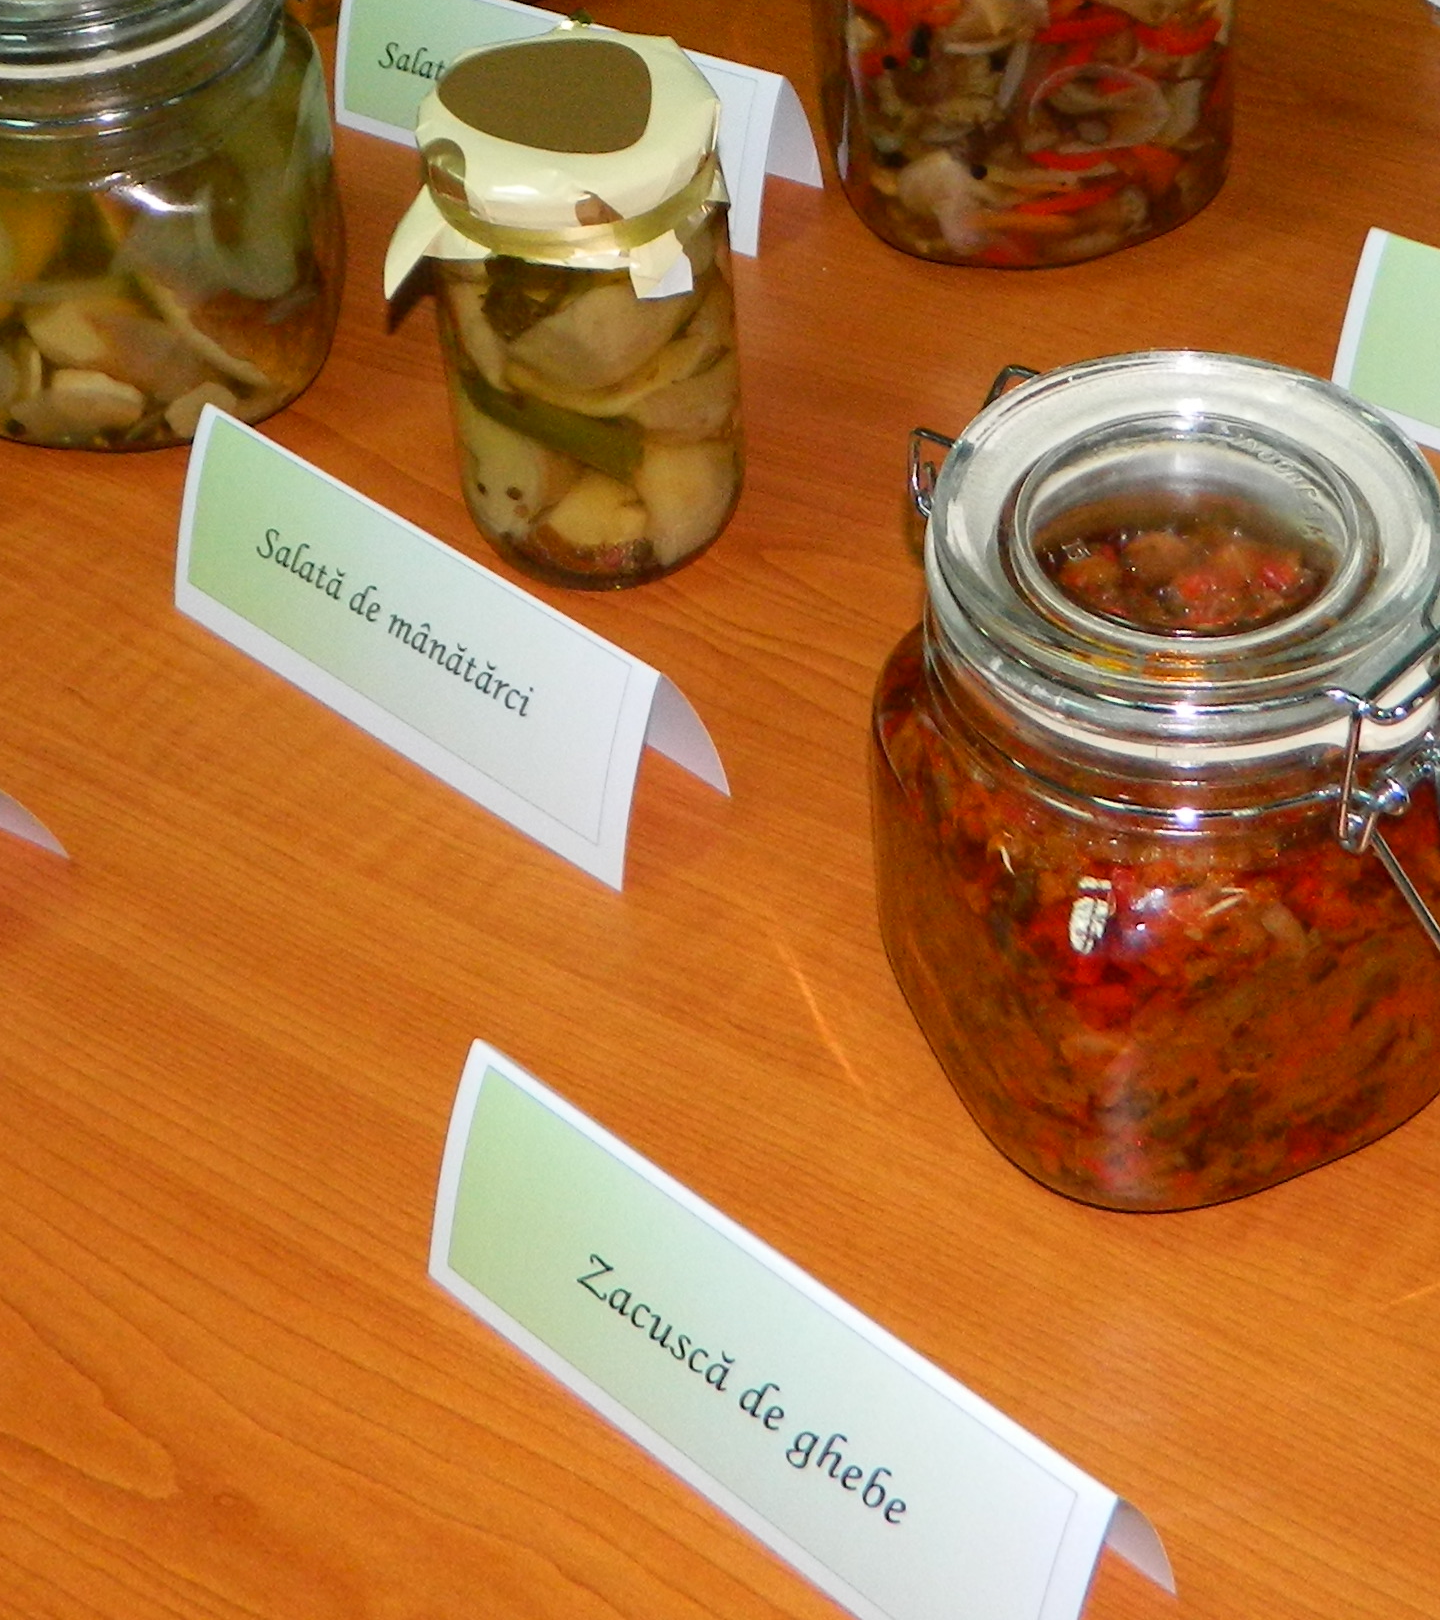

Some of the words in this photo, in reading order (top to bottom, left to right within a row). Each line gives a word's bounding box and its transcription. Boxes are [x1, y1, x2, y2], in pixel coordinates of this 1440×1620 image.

[378, 41, 447, 82] Salat
[256, 527, 347, 602] Salată
[348, 584, 382, 624] de
[386, 613, 535, 719] mânătărci
[575, 1253, 736, 1394] Zacuscă
[738, 1381, 787, 1432] de
[785, 1429, 908, 1528] ghebe
